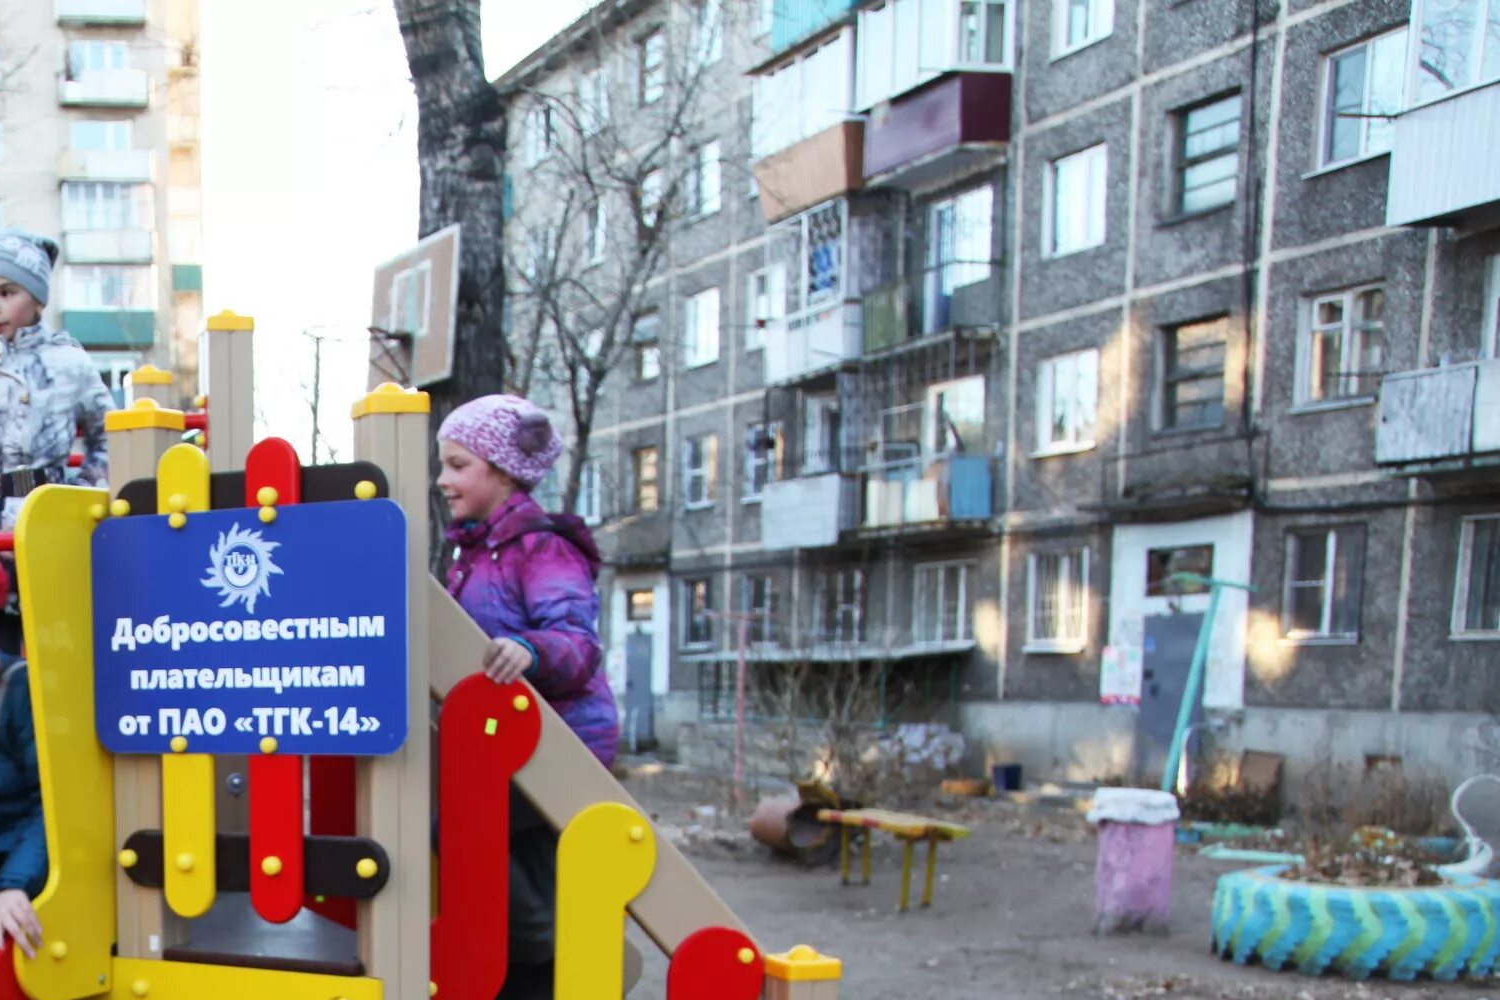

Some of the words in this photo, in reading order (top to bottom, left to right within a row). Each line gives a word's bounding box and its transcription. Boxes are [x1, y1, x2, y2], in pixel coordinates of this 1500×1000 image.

[111, 615, 384, 650] Добросовестным
[130, 665, 364, 693] плательщикам
[118, 714, 149, 735] от
[158, 707, 225, 735] ПАО
[234, 706, 380, 736] «ТГК-14»
